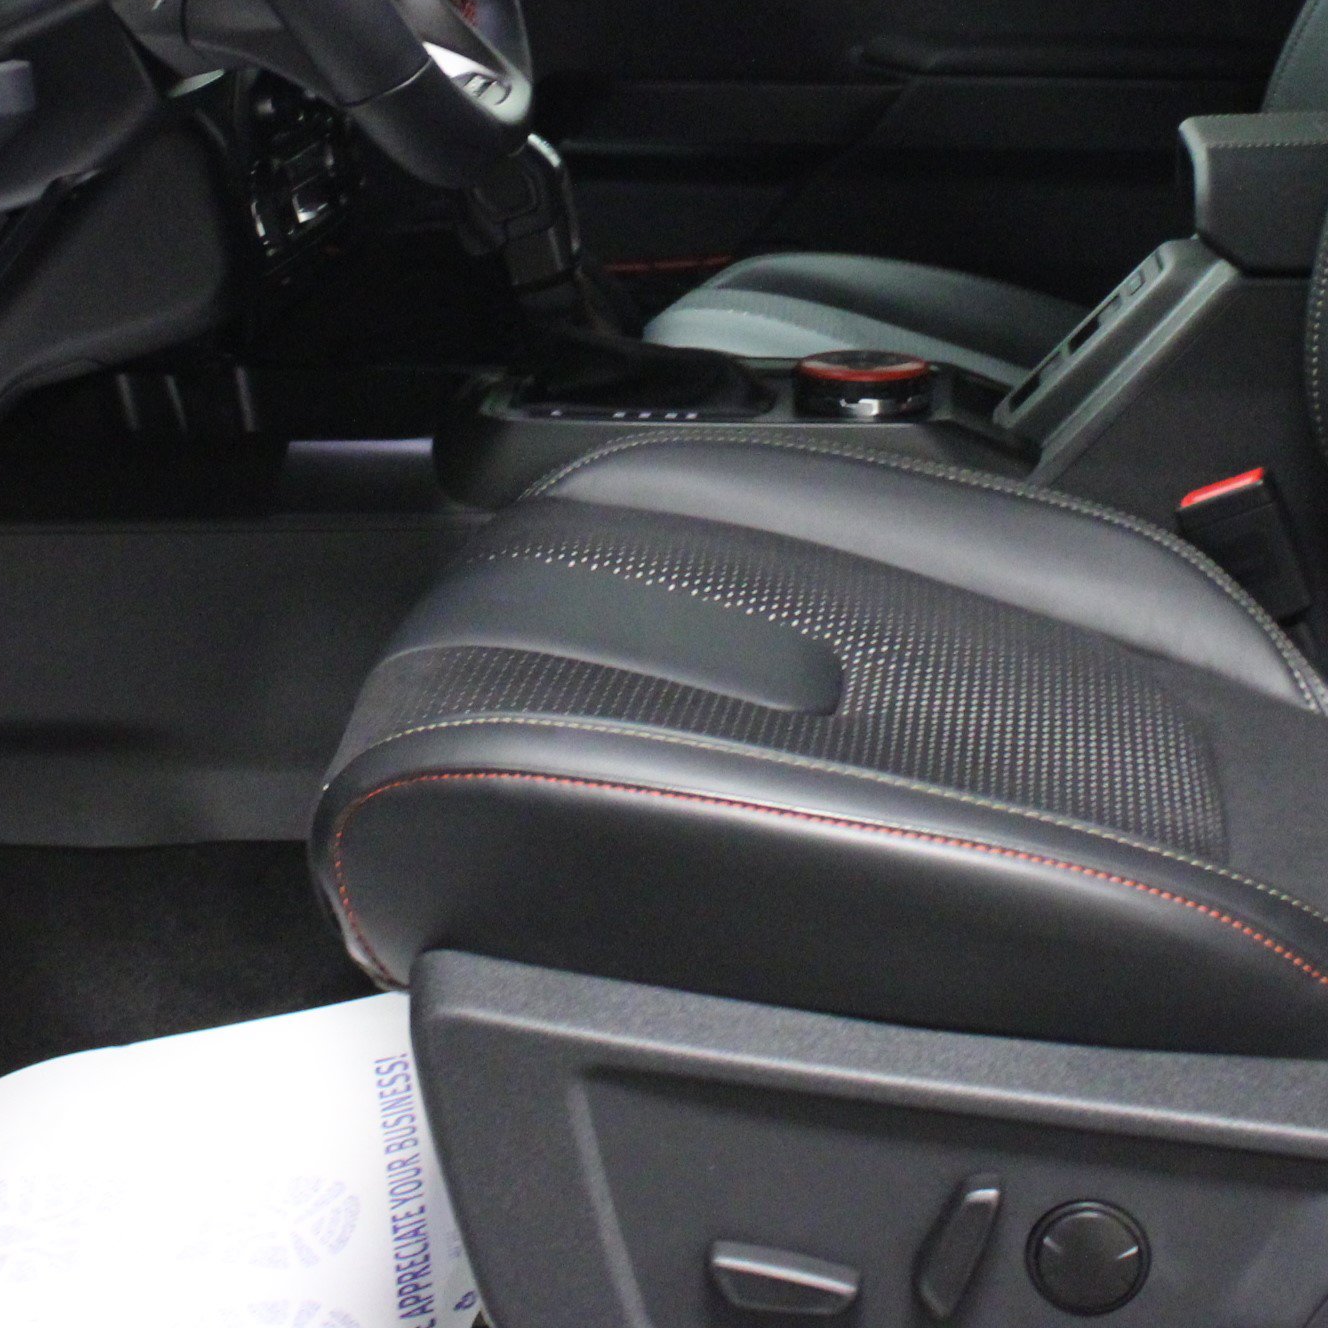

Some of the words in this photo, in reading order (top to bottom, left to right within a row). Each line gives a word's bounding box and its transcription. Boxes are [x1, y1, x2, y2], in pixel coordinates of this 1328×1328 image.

[374, 1052, 419, 1155] BUSINESS!
[386, 1152, 425, 1210] YOUR
[390, 1204, 435, 1320] APPRECIATE
